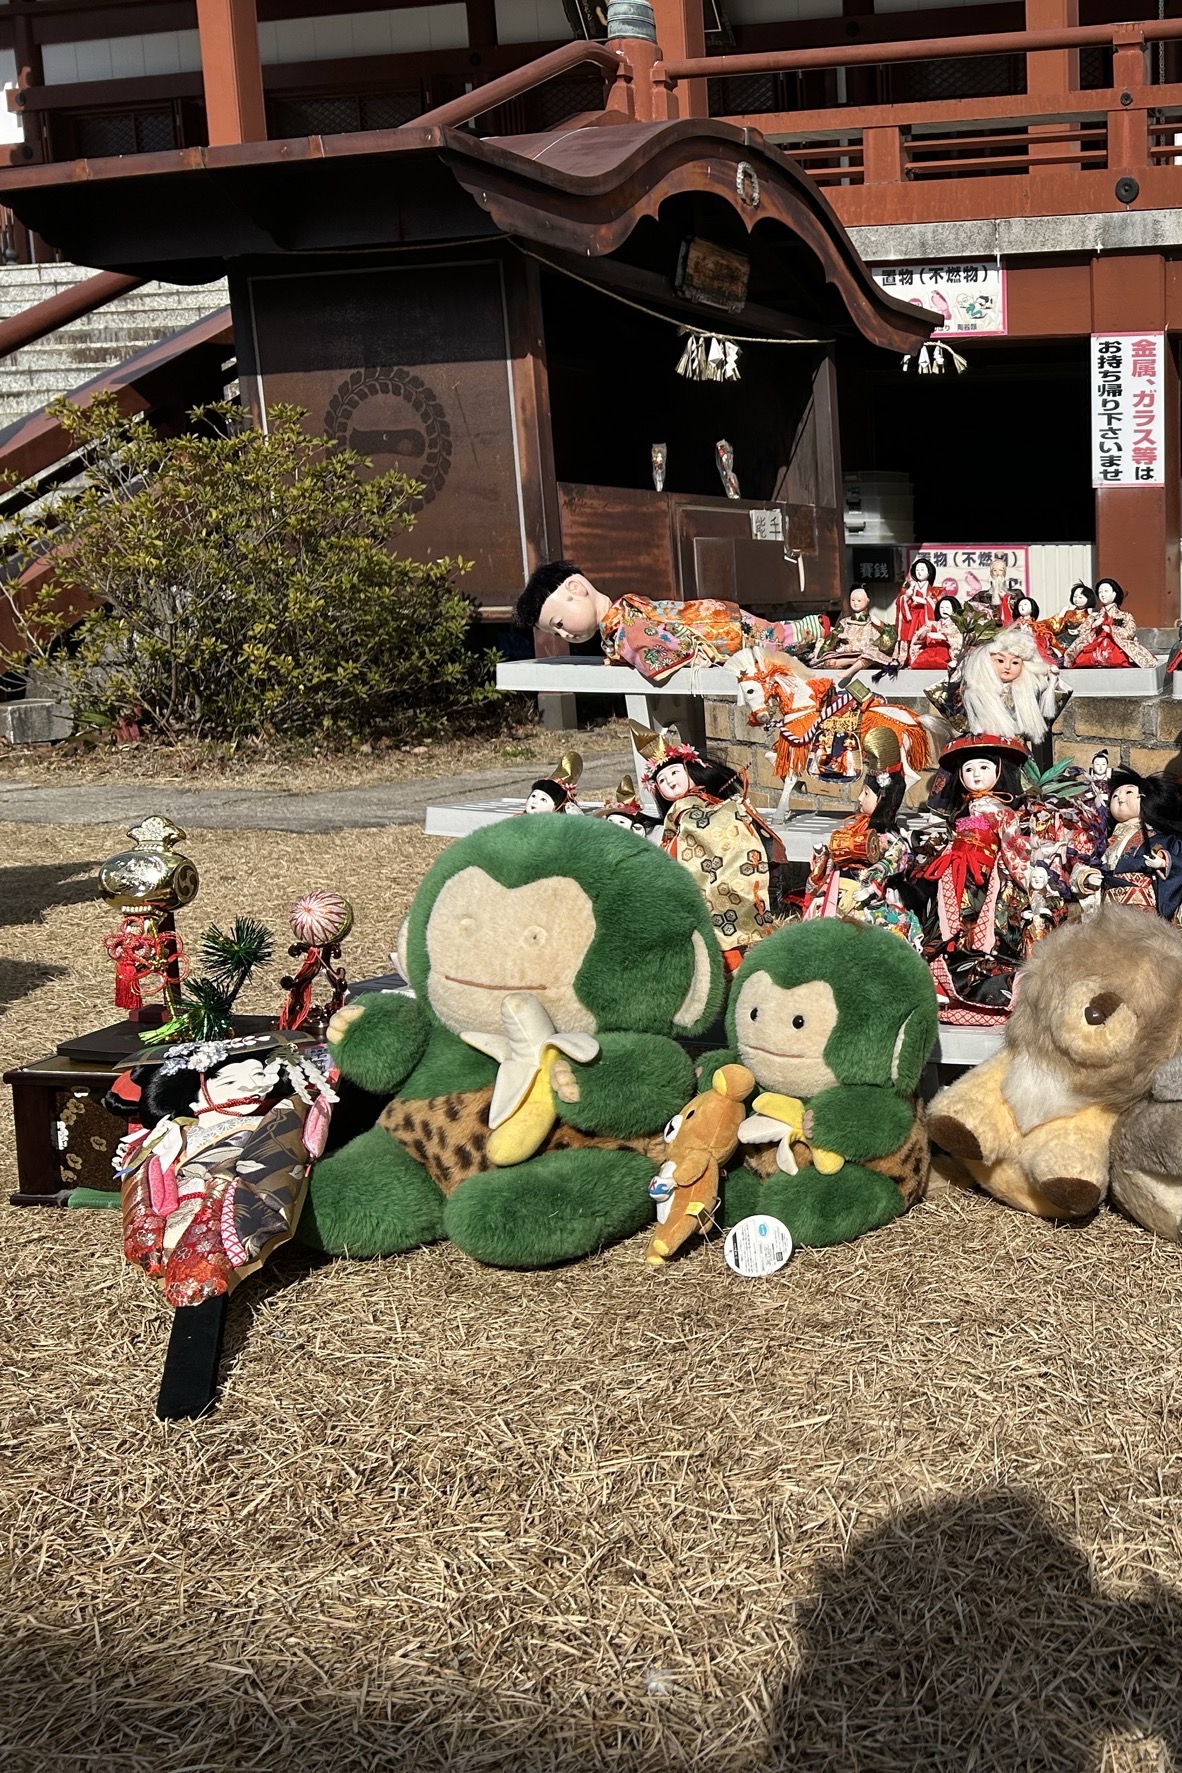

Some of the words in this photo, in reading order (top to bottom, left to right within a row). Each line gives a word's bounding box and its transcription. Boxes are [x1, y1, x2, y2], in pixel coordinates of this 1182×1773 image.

[881, 265, 988, 286] 置物（不燃物）
[1097, 340, 1123, 482] お持ち帰り下さいませ
[1131, 338, 1158, 481] 金属、ガラス等は
[859, 562, 889, 579] 賽銭
